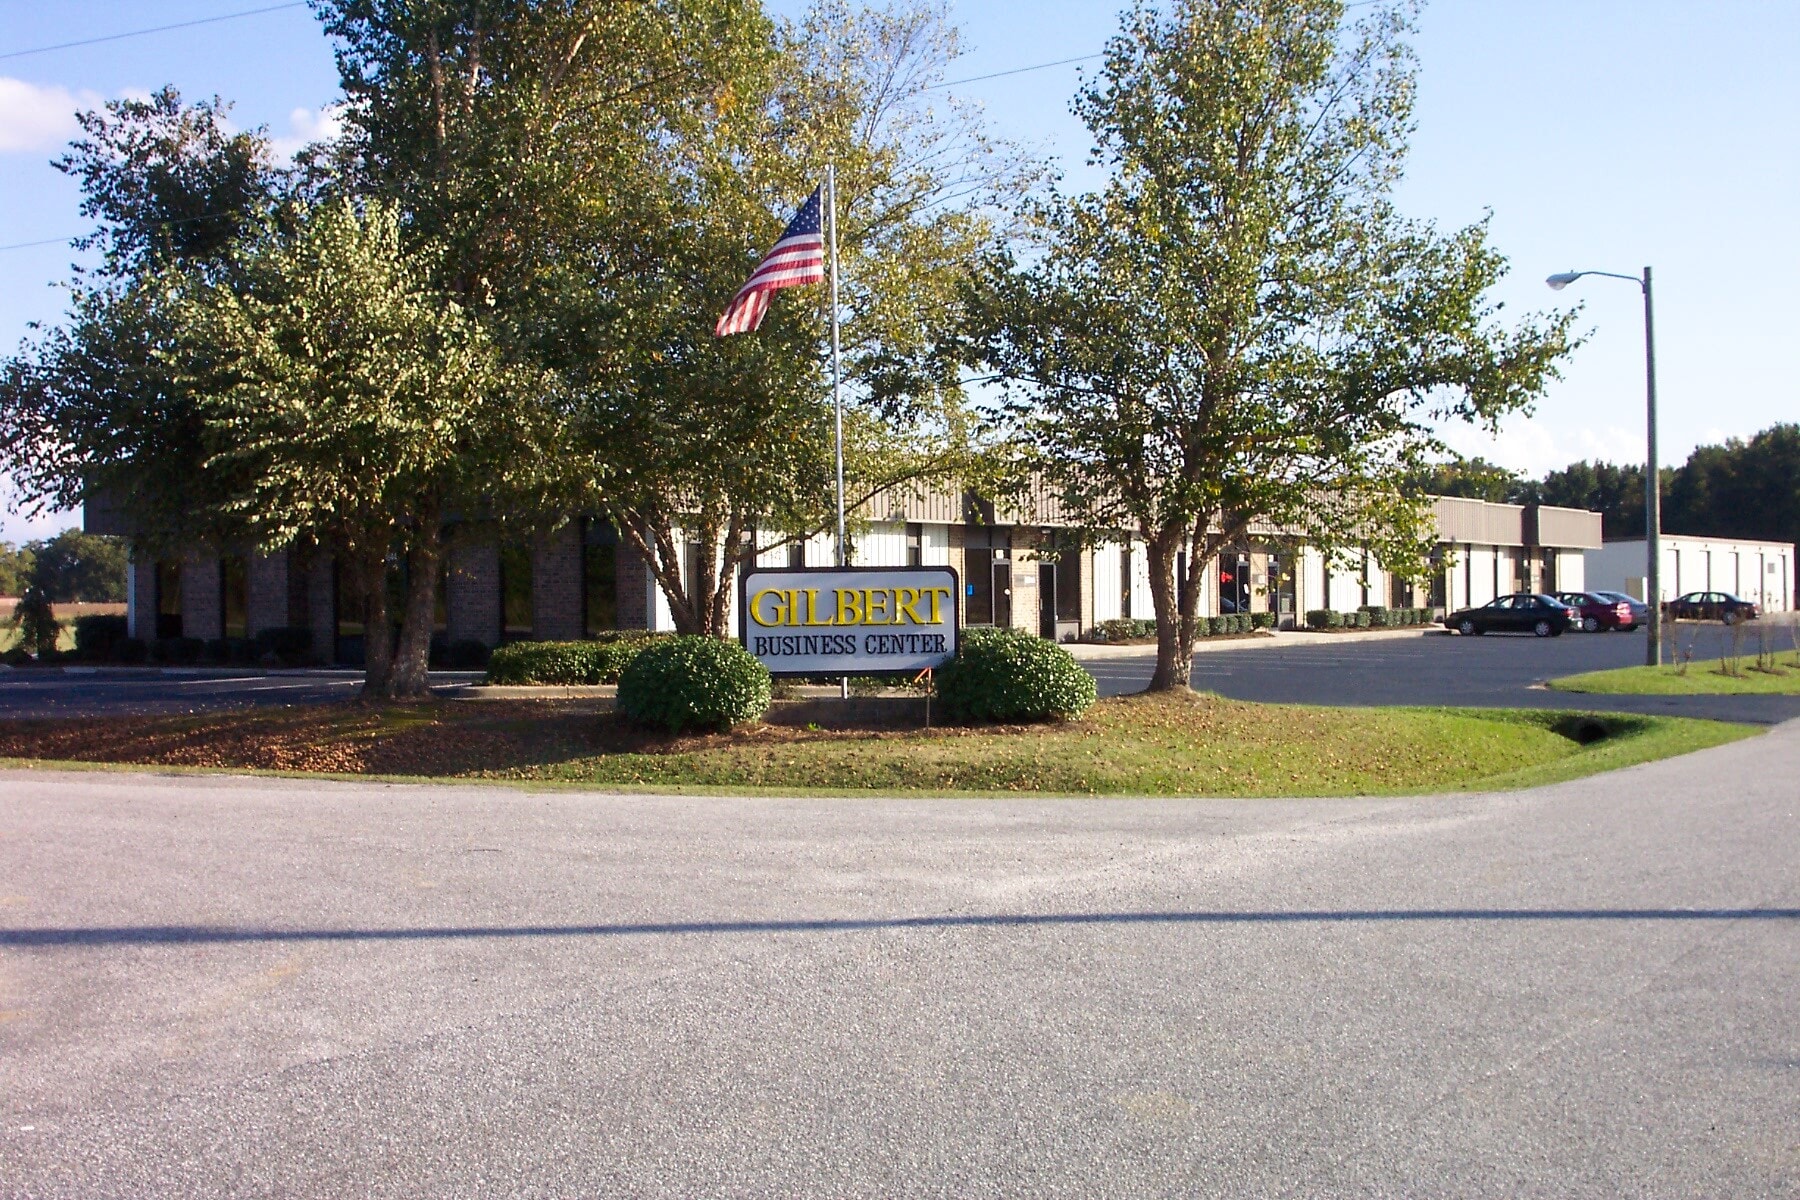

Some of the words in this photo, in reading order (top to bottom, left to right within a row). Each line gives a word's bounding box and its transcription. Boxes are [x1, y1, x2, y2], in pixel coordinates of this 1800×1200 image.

[750, 588, 950, 627] GILBERT
[754, 634, 856, 656] BUSINESS
[865, 634, 948, 654] CENTER
